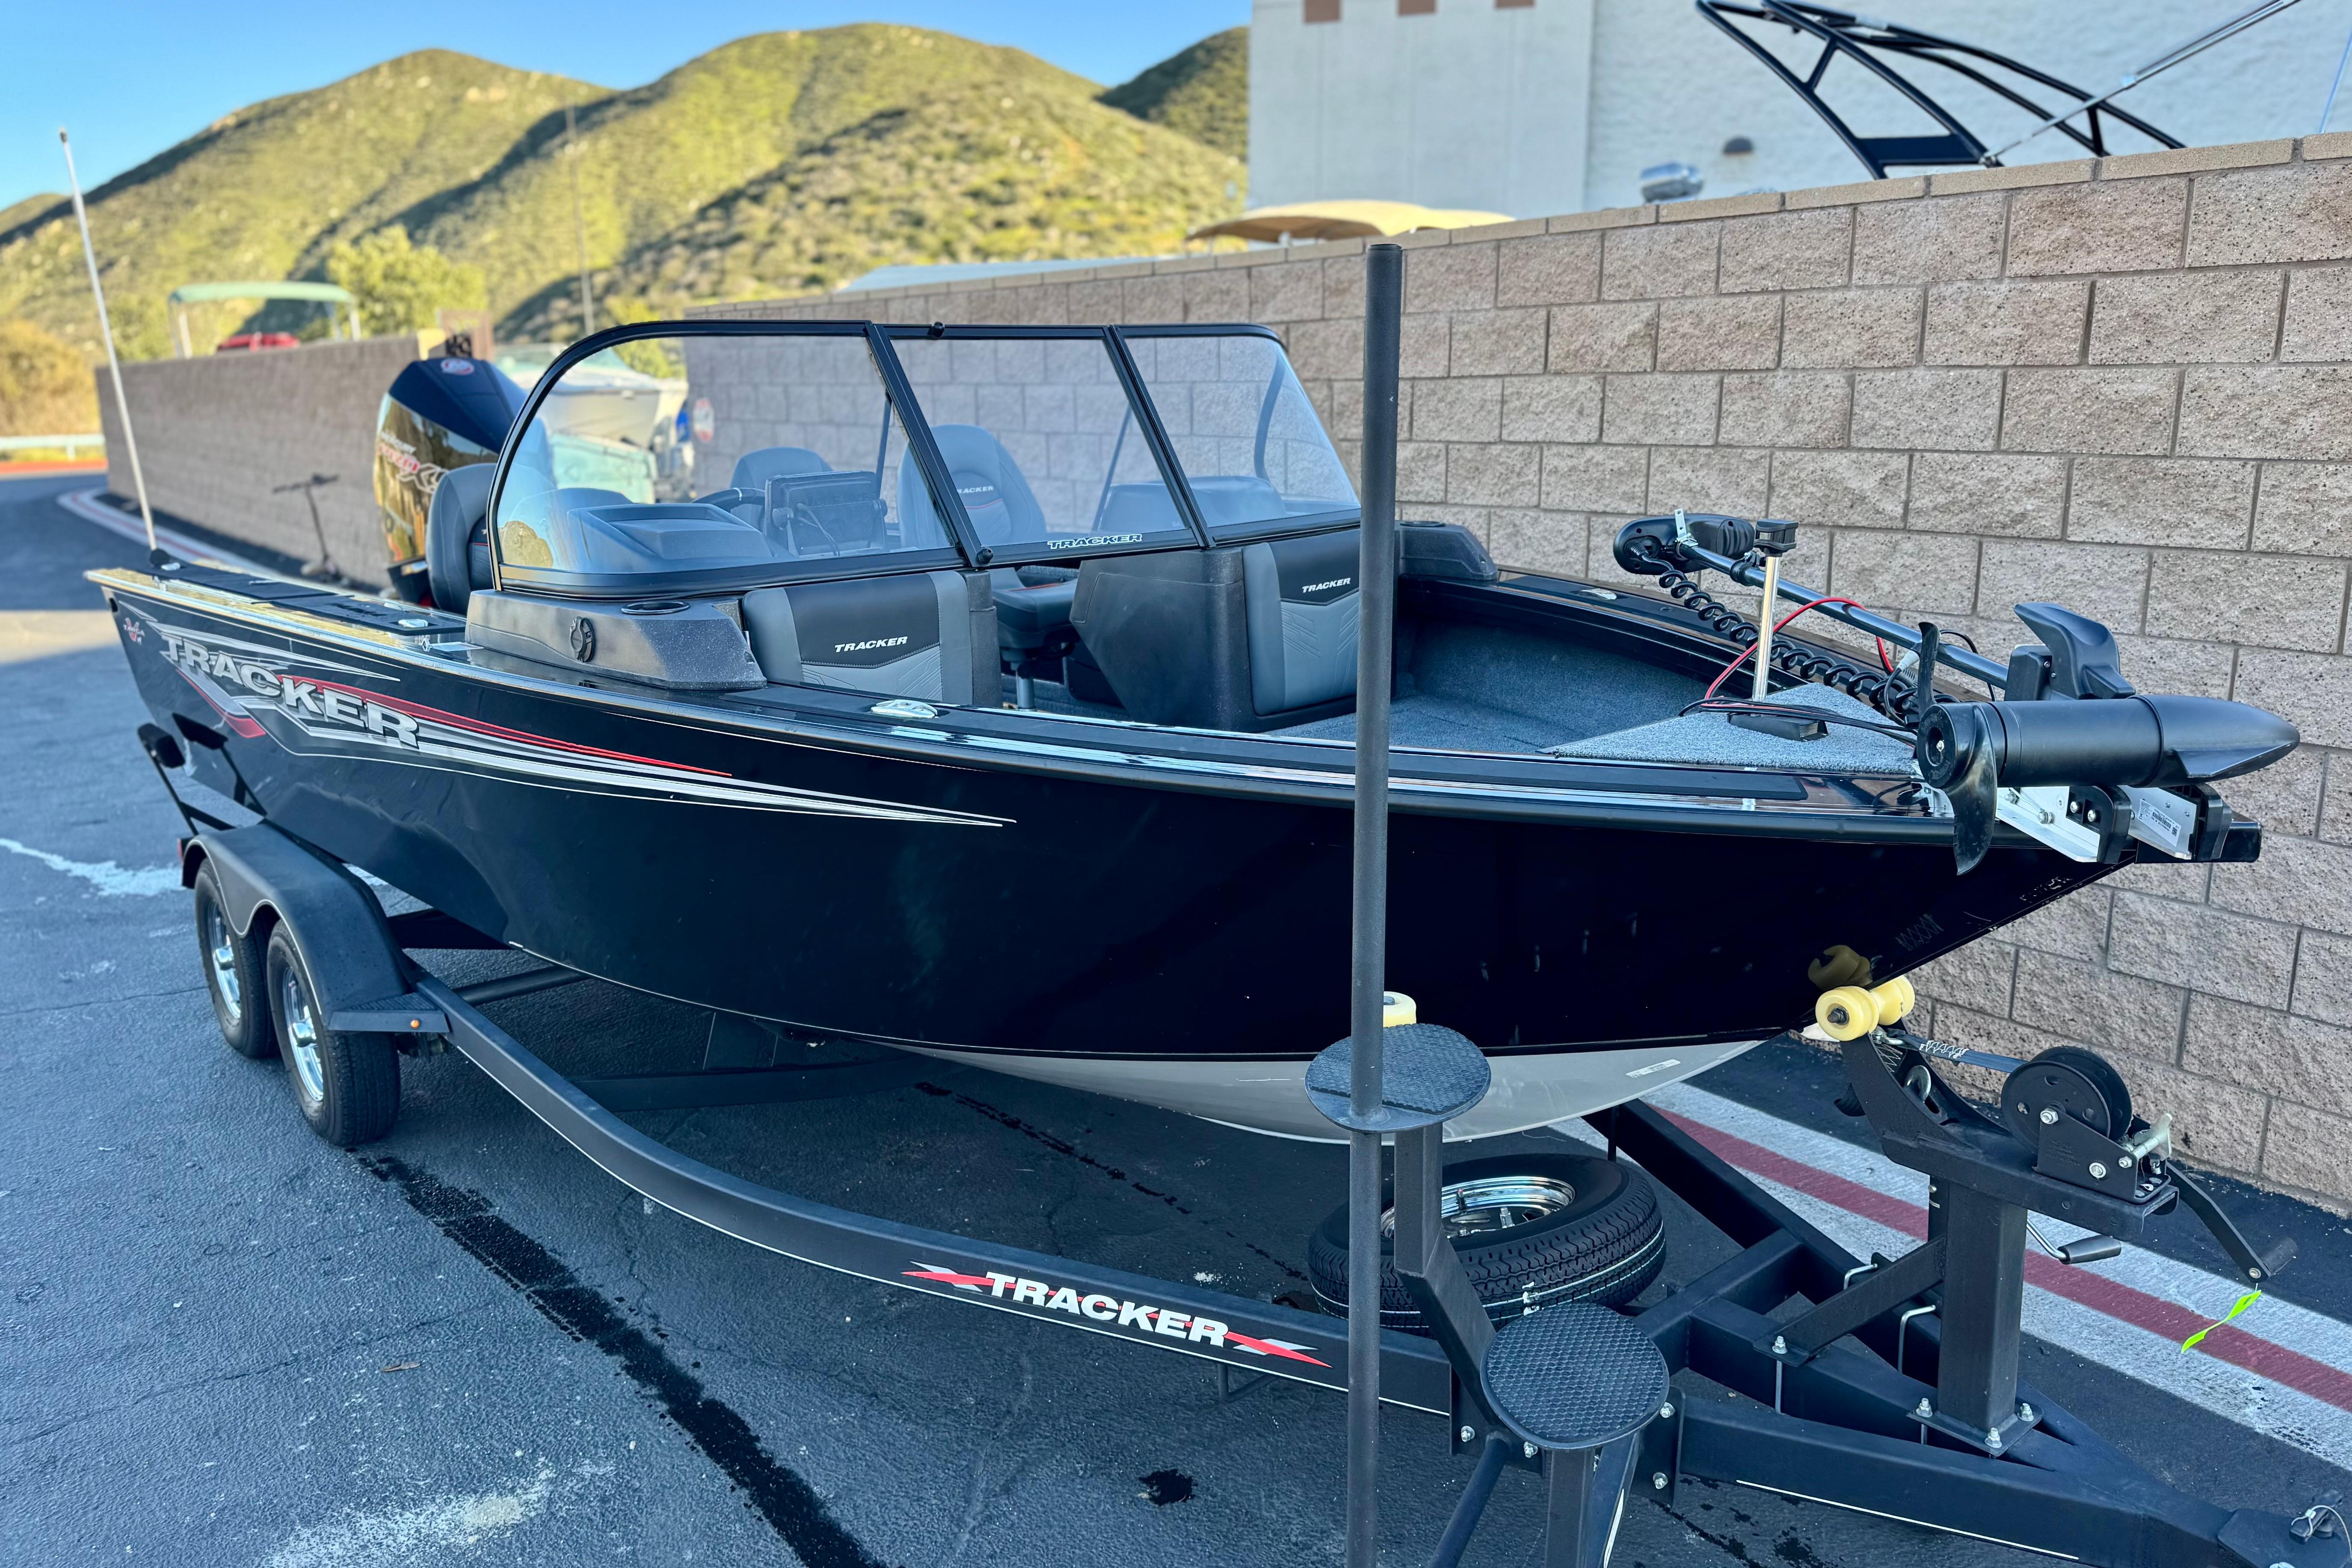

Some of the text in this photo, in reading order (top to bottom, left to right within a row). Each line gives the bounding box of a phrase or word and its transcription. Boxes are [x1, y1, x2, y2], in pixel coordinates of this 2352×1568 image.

[957, 486, 993, 494] RACKER
[1047, 534, 1142, 549] TRACKER
[1302, 578, 1351, 593] TRACKER
[835, 636, 908, 653] TRACKER
[161, 633, 420, 750] TRACKER
[985, 1271, 1229, 1348] TRACKER
